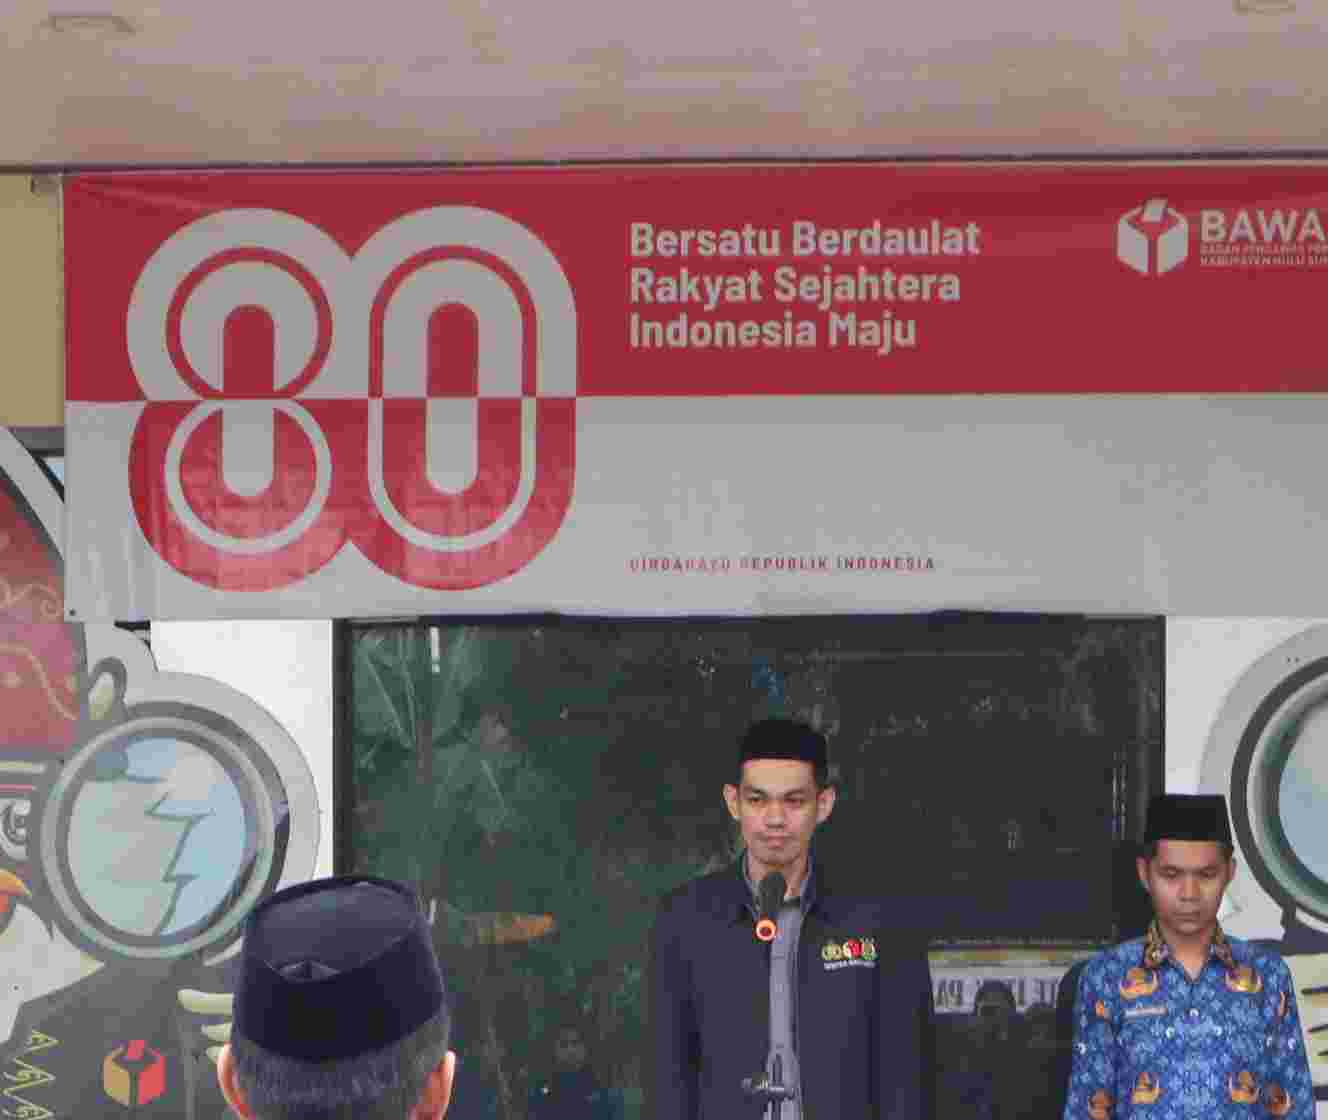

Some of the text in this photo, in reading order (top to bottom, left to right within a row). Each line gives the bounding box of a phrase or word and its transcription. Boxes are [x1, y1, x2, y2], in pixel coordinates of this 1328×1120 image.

[629, 219, 981, 256] Bersatu Berdaulat
[629, 265, 961, 310] Rakyat Sejahtera
[629, 311, 916, 355] Indonesia Maju
[126, 205, 577, 591] 80
[837, 552, 934, 569] INDONESIA
